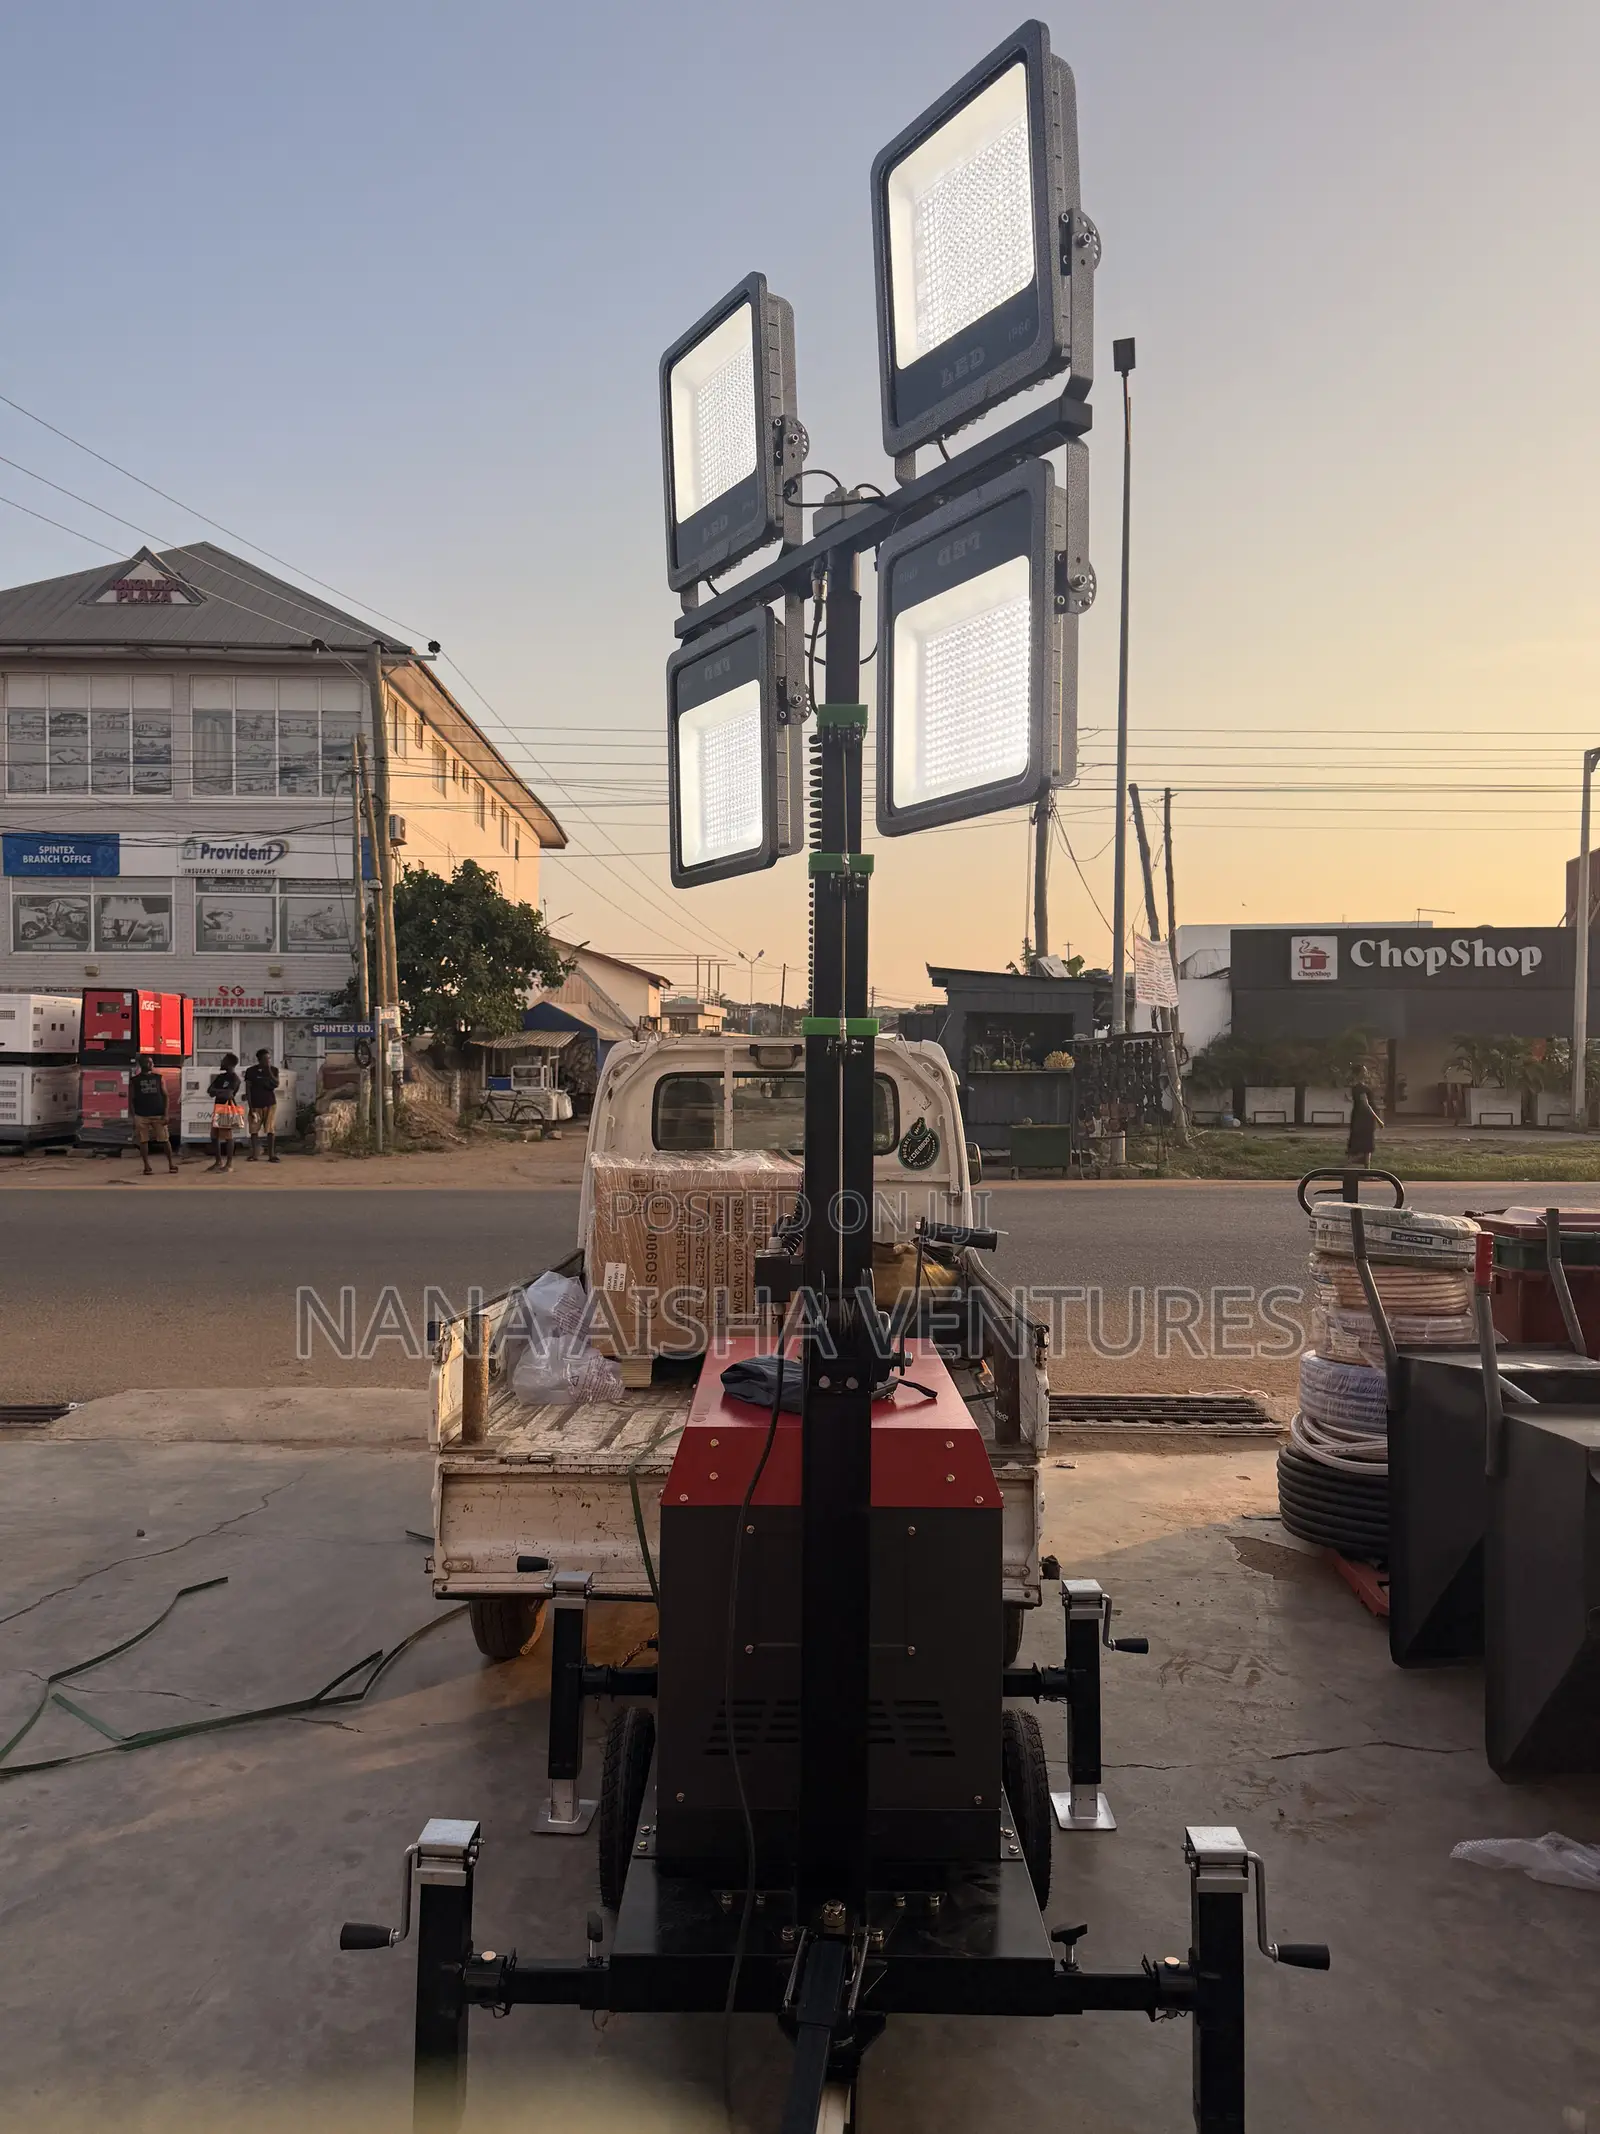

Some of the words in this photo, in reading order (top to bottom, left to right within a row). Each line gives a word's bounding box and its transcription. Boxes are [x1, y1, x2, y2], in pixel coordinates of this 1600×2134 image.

[941, 346, 985, 388] LED
[116, 590, 172, 603] PLAZA
[39, 845, 75, 854] SPINTEX
[200, 842, 273, 860] Provident
[23, 855, 60, 863] BRANCH
[62, 855, 91, 863] OFFICE
[1350, 938, 1543, 977] ChopShop
[1297, 970, 1332, 979] ChopShop
[192, 998, 263, 1007] ENTERPRISE
[313, 1024, 355, 1033] SPINTEX
[357, 1024, 373, 1032] RD.
[733, 1272, 744, 1326] NW/G.W:
